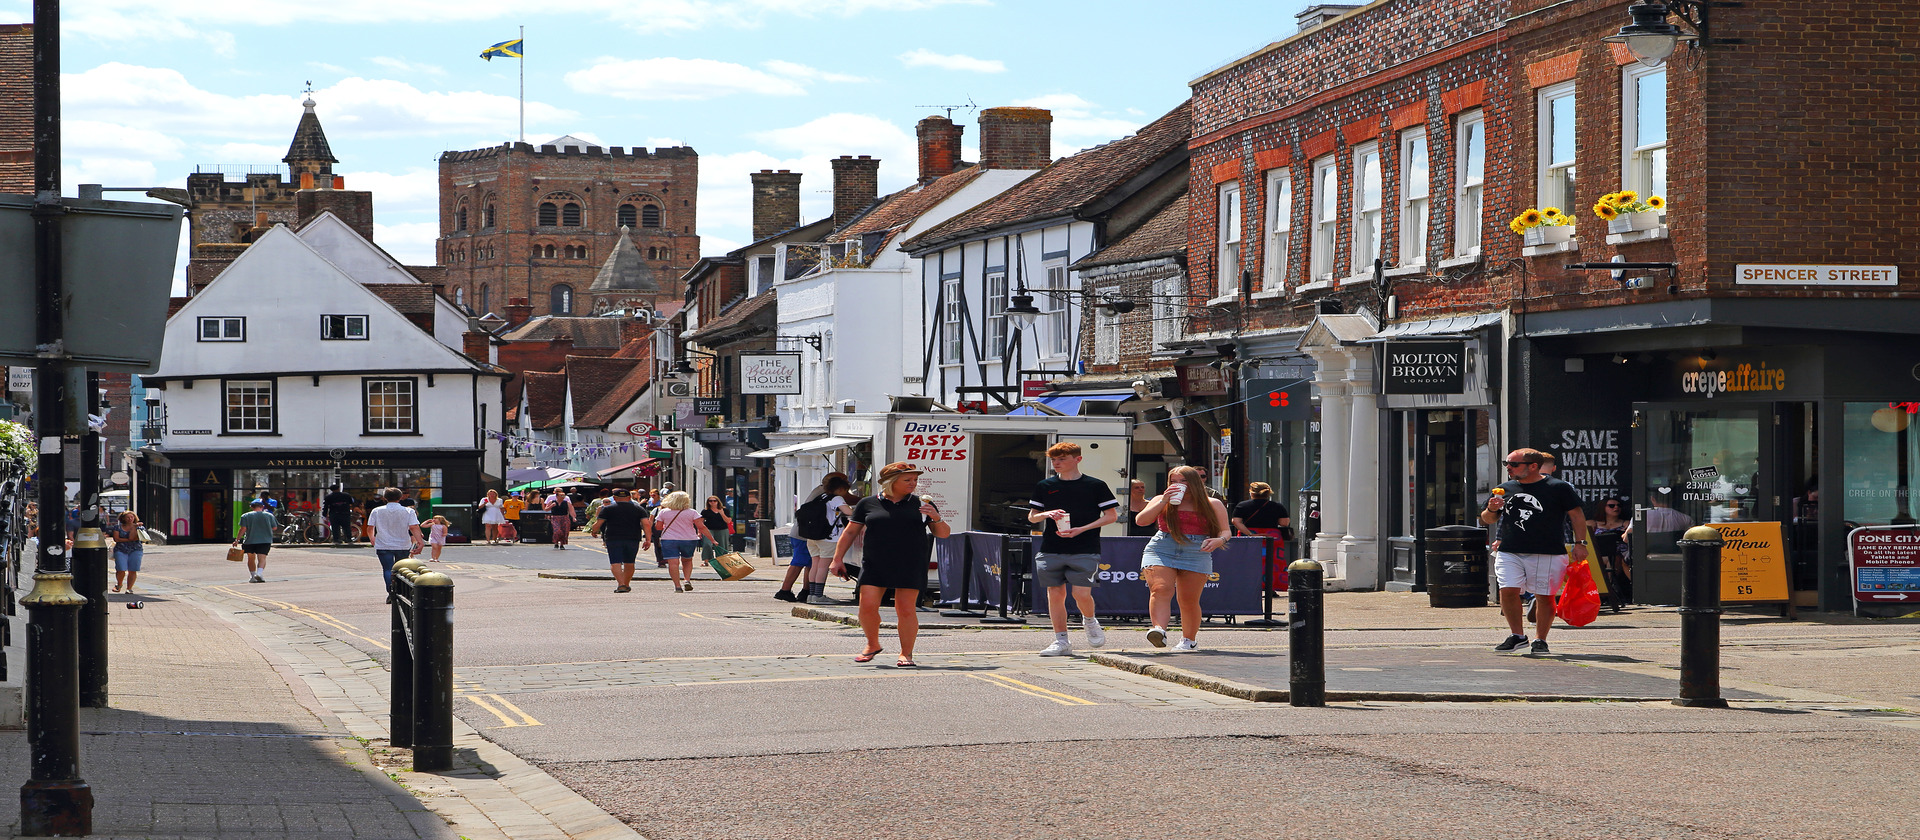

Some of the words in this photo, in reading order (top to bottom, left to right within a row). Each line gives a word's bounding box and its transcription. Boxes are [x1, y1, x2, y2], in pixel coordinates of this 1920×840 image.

[1743, 268, 1818, 281] SPENCER
[1828, 269, 1892, 281] STREET
[759, 359, 782, 367] THE
[1392, 353, 1458, 365] MOLTON
[745, 364, 794, 378] Beauty
[1392, 365, 1458, 377] BROWN
[748, 376, 792, 384] HOUSE
[904, 422, 960, 433] Dave's
[902, 434, 966, 447] TASTY
[1561, 429, 1619, 449] SAVE
[907, 448, 967, 461] BITES
[1561, 452, 1619, 467] WATER
[203, 470, 220, 484] A
[1561, 469, 1618, 486] DRINK
[1574, 488, 1619, 502] OFFEE
[1848, 489, 1876, 498] CREPE
[1879, 489, 1891, 498] ON
[1894, 489, 1909, 498] THE
[1726, 539, 1770, 551] Menu
[1859, 535, 1892, 543] FONE
[1895, 535, 1920, 543] CITY
[1737, 585, 1753, 595] £5
